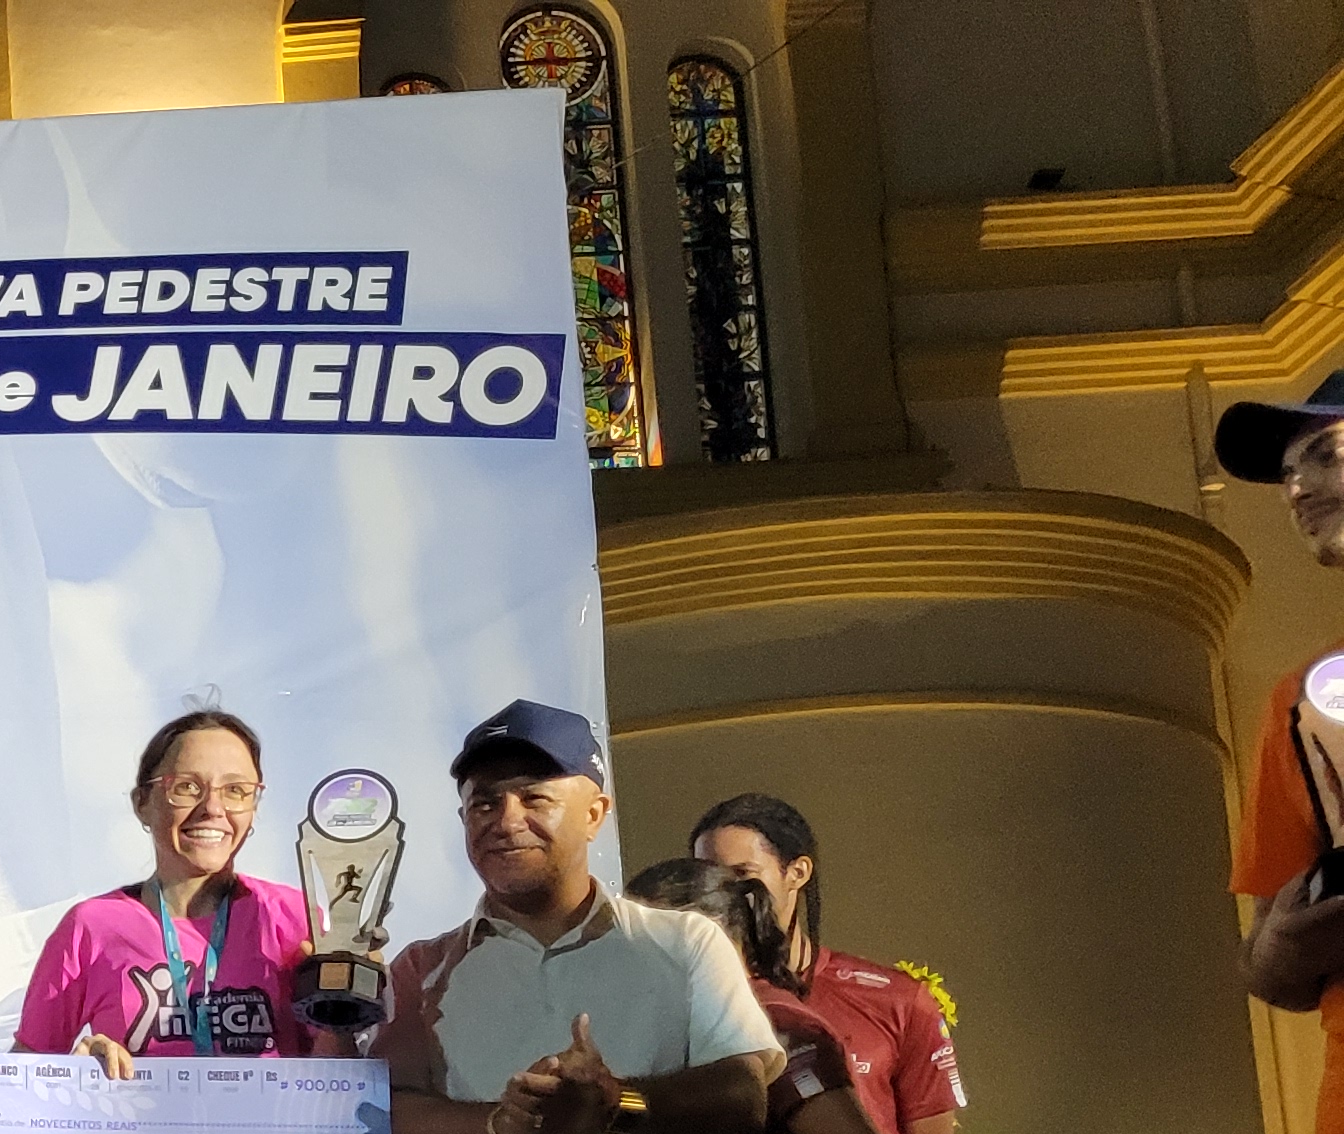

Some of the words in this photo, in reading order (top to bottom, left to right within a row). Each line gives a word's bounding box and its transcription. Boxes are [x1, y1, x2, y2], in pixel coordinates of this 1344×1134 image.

[58, 266, 393, 317] PEDESTRE
[51, 343, 551, 427] JANEIRO
[36, 1065, 71, 1078] AGÊNCIA
[90, 1070, 100, 1080] C1
[178, 1071, 190, 1081] C2
[208, 1071, 240, 1081] CHEQUE
[296, 1080, 351, 1093] 900,00
[31, 1118, 102, 1130] NOVECENTOS
[107, 1120, 137, 1131] REAIS
